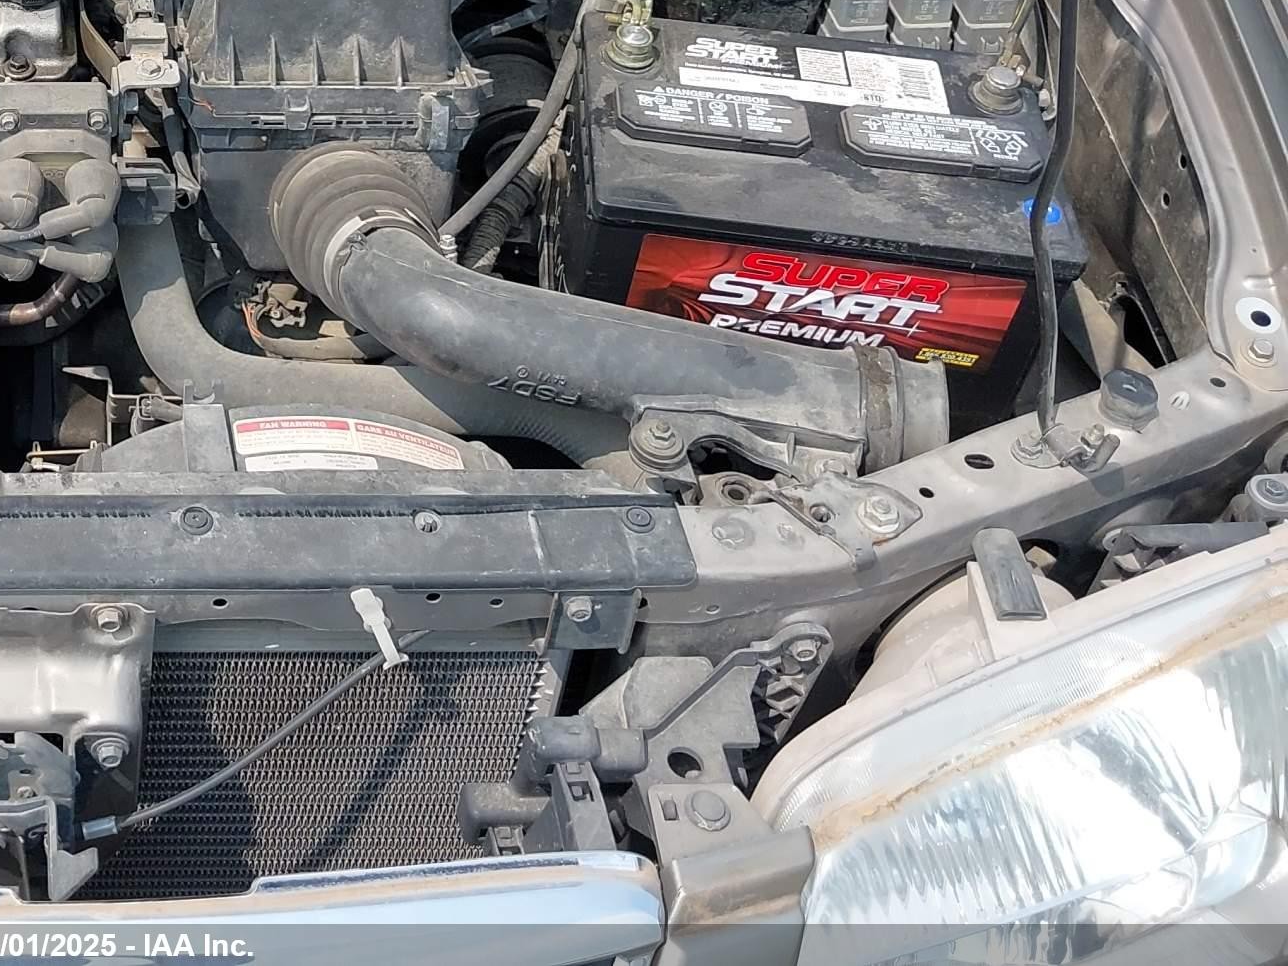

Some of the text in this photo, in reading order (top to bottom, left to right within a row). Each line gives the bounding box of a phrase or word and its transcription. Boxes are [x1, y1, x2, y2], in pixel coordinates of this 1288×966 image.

[685, 44, 779, 65] START
[695, 37, 778, 55] SUPER
[666, 87, 713, 100] DANGER
[725, 93, 769, 105] POISON
[735, 252, 949, 303] SUPER
[698, 273, 941, 327] START
[712, 313, 885, 348] PREMIUM
[259, 420, 328, 429] FAN WARNING
